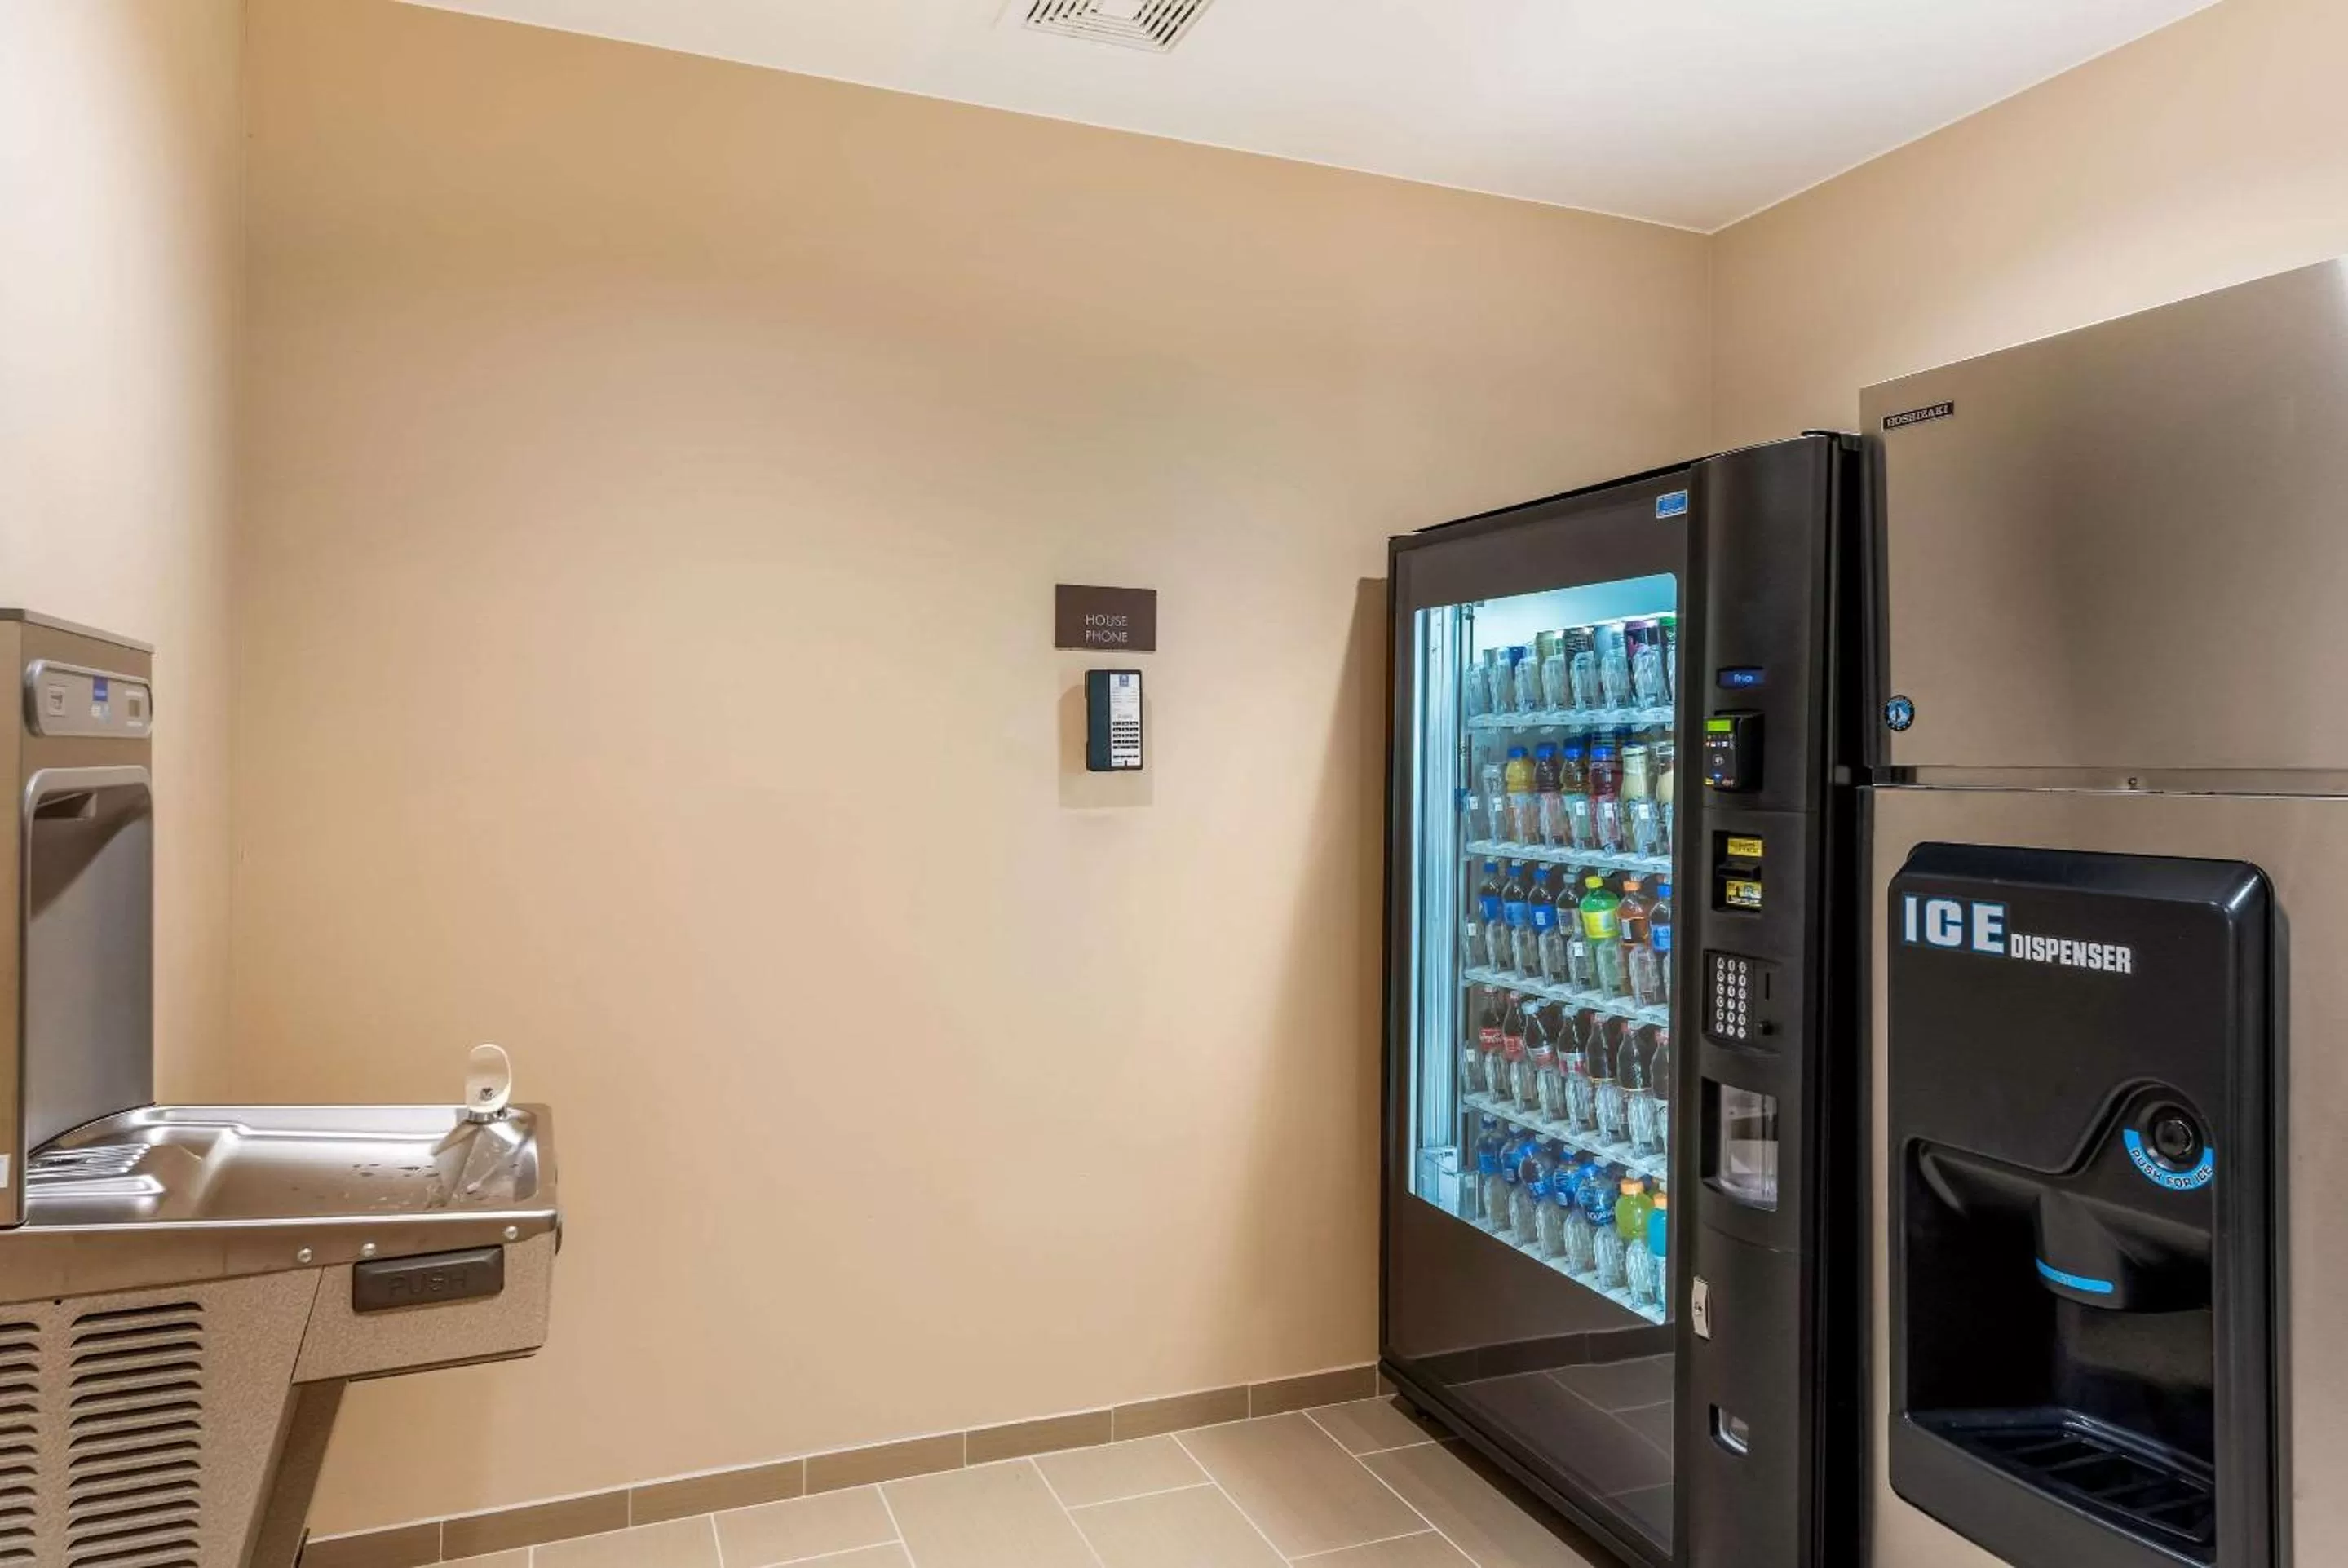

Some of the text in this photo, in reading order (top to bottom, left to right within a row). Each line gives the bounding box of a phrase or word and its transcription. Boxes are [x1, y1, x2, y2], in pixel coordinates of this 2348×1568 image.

[1886, 405, 1948, 426] HOSHIZAKI
[1086, 614, 1128, 627] HOUSE
[1086, 629, 1128, 643] PHONE
[1904, 895, 2132, 974] ICE DISPENSER
[2131, 1149, 2213, 1188] PUSH FOR ICE
[388, 1267, 468, 1298] PUSH
